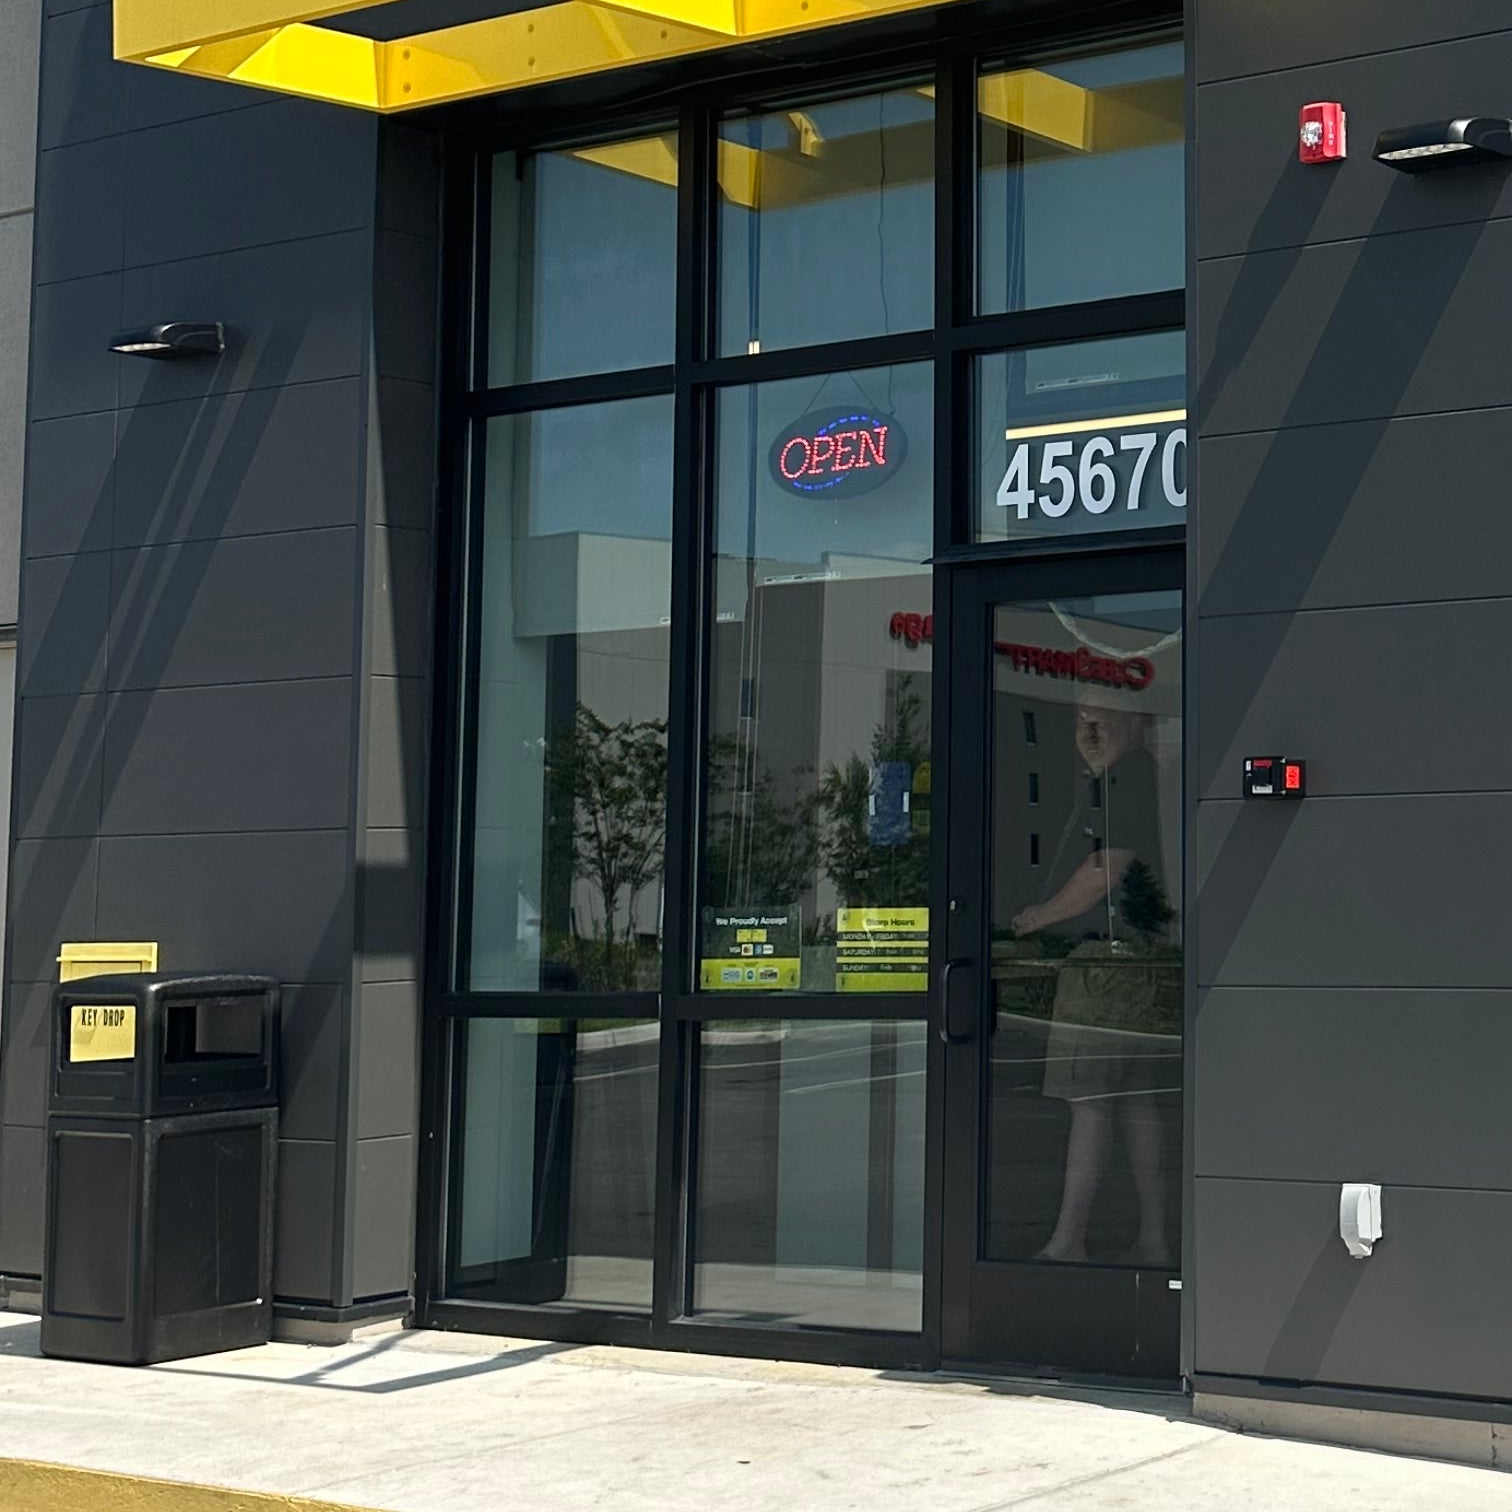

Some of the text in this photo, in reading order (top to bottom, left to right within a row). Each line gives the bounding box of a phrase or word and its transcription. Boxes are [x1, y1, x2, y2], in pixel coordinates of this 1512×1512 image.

[779, 426, 890, 481] OPEN
[997, 427, 1187, 520] 45670
[729, 917, 759, 927] Proudly
[760, 916, 788, 926] Accept
[890, 918, 916, 926] Hours
[81, 1008, 125, 1027] KEY DROP
